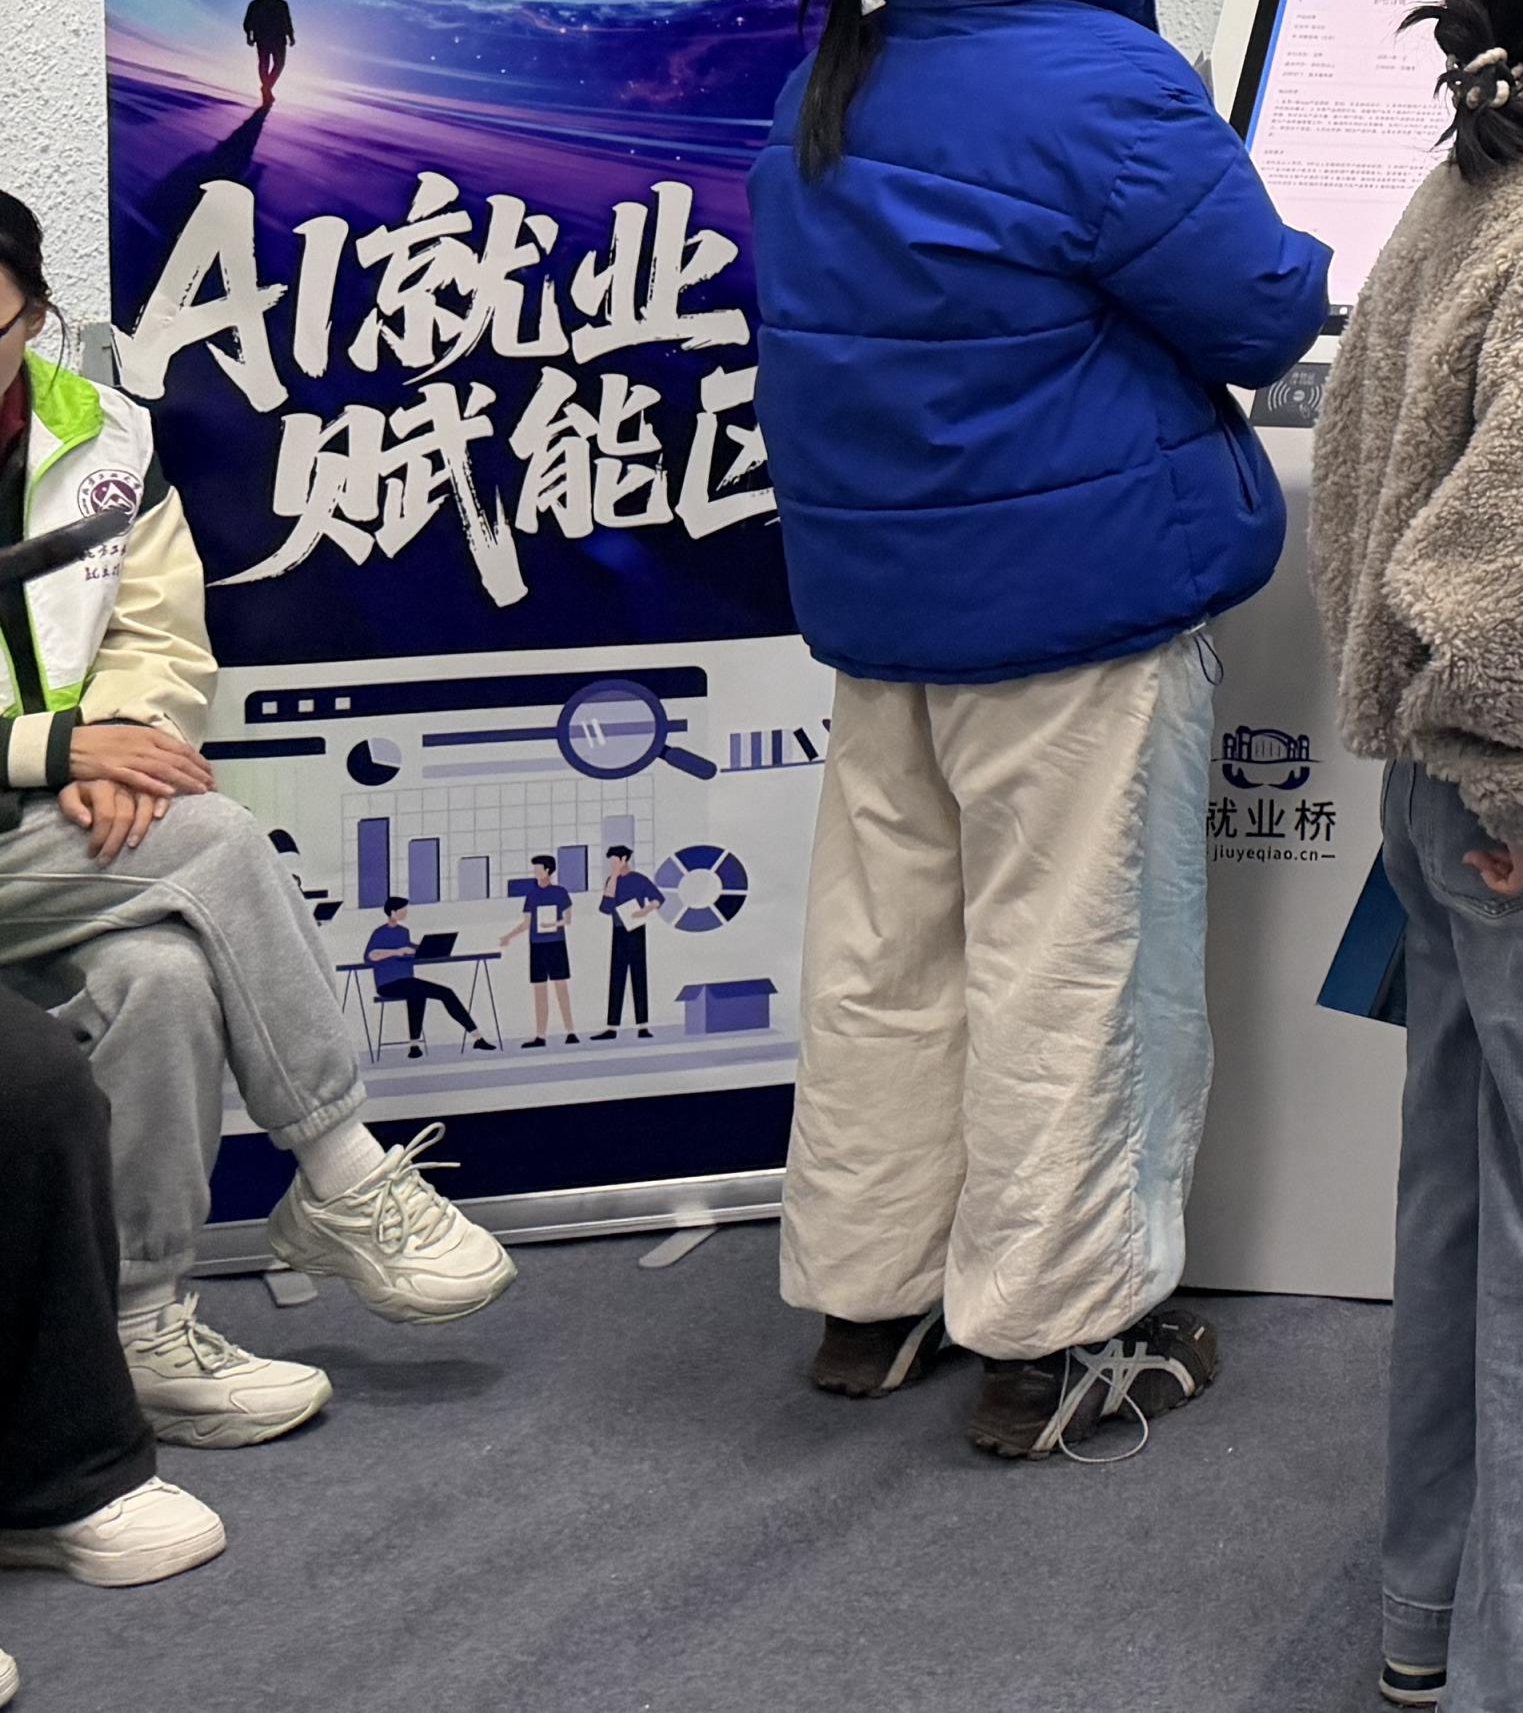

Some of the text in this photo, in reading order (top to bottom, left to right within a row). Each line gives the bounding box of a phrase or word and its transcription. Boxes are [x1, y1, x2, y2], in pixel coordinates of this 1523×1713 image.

[112, 172, 751, 412] AI就业
[1206, 797, 1336, 841] 就业桥
[1213, 844, 1318, 862] jiuyeqiao.cn
